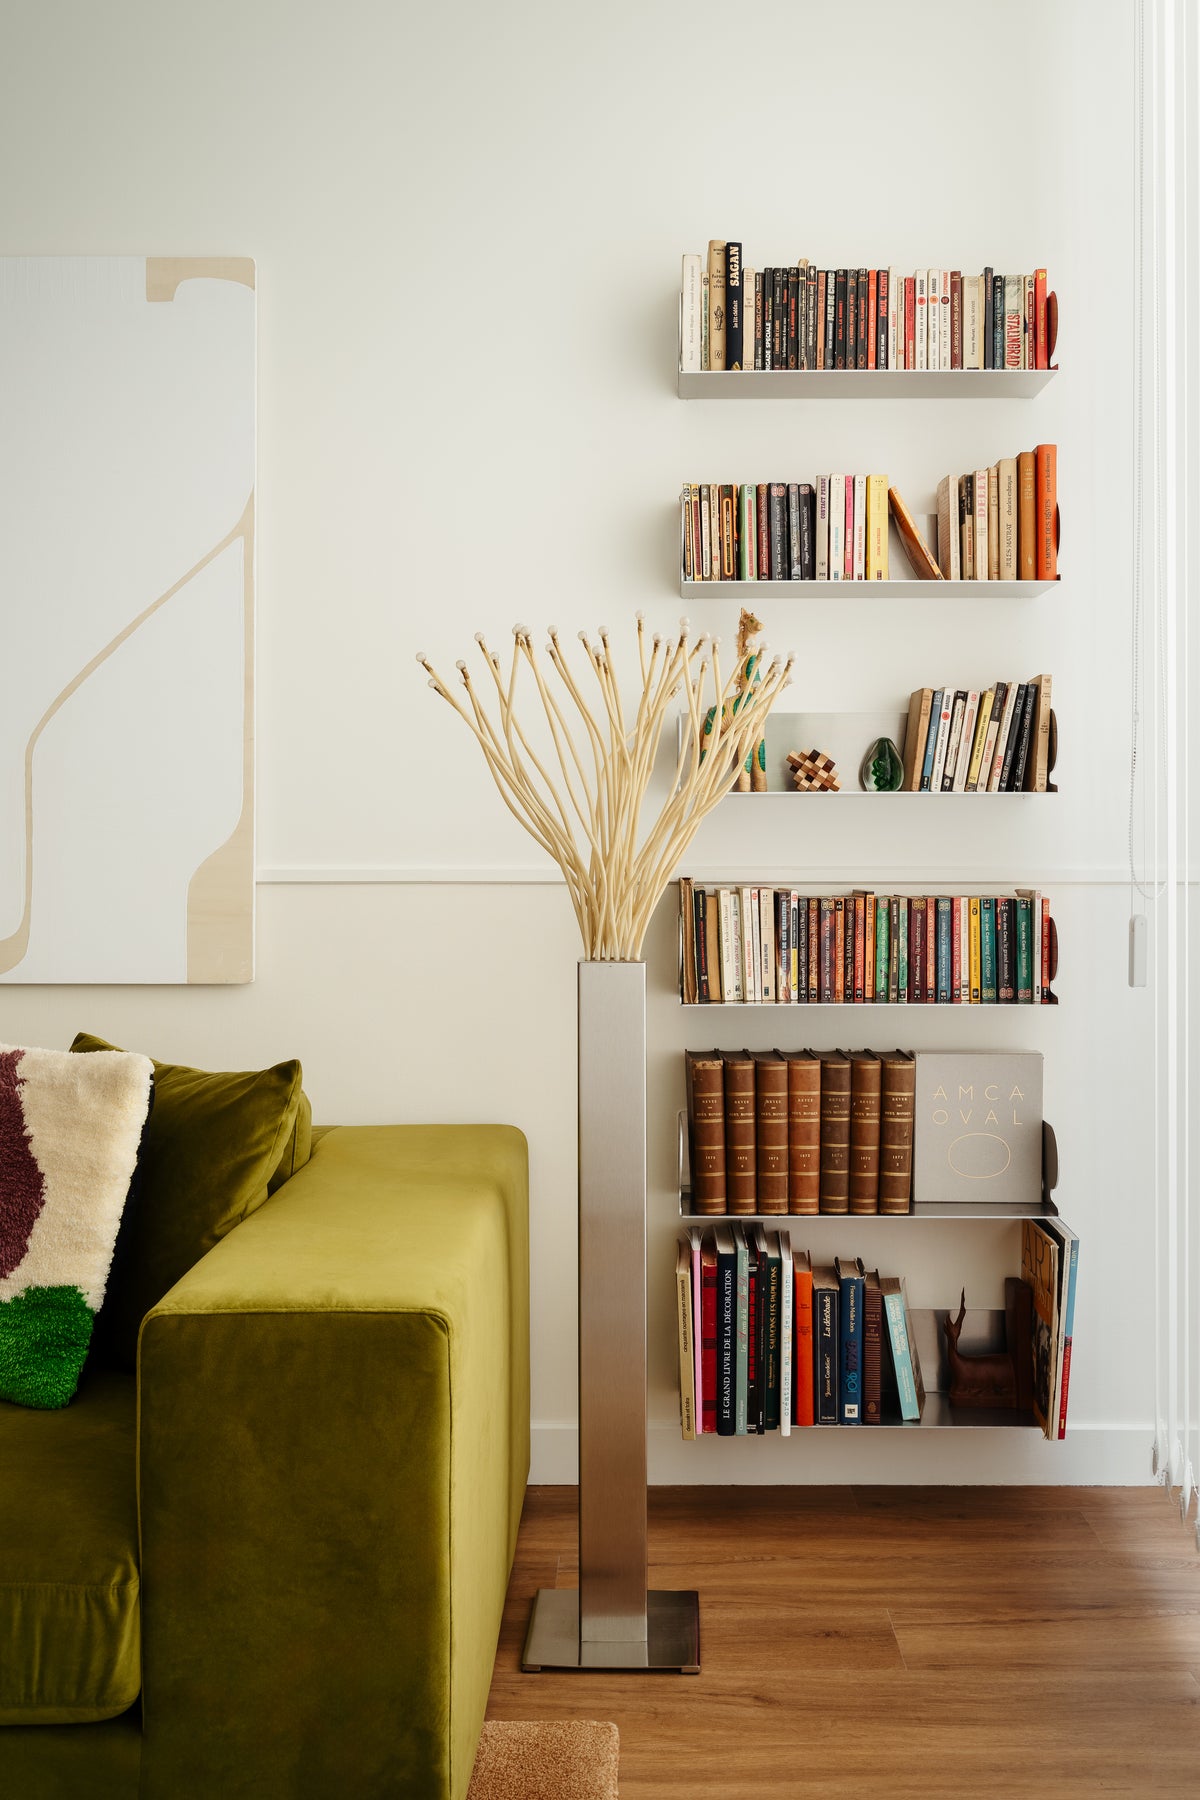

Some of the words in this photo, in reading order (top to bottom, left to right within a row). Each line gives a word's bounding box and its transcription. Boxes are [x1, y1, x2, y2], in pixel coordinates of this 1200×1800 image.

[730, 246, 739, 287] SAGAN
[827, 294, 835, 306] DE
[1006, 314, 1020, 367] STALINGRAD
[977, 472, 986, 518] DELLY
[932, 1086, 1024, 1101] AMCA
[932, 1109, 1023, 1125] OVAL
[722, 1269, 731, 1324] DÉCORATION
[724, 1326, 731, 1336] LA
[823, 1327, 831, 1338] La
[724, 1338, 730, 1349] DE
[783, 1357, 790, 1366] au
[723, 1409, 730, 1418] LE
